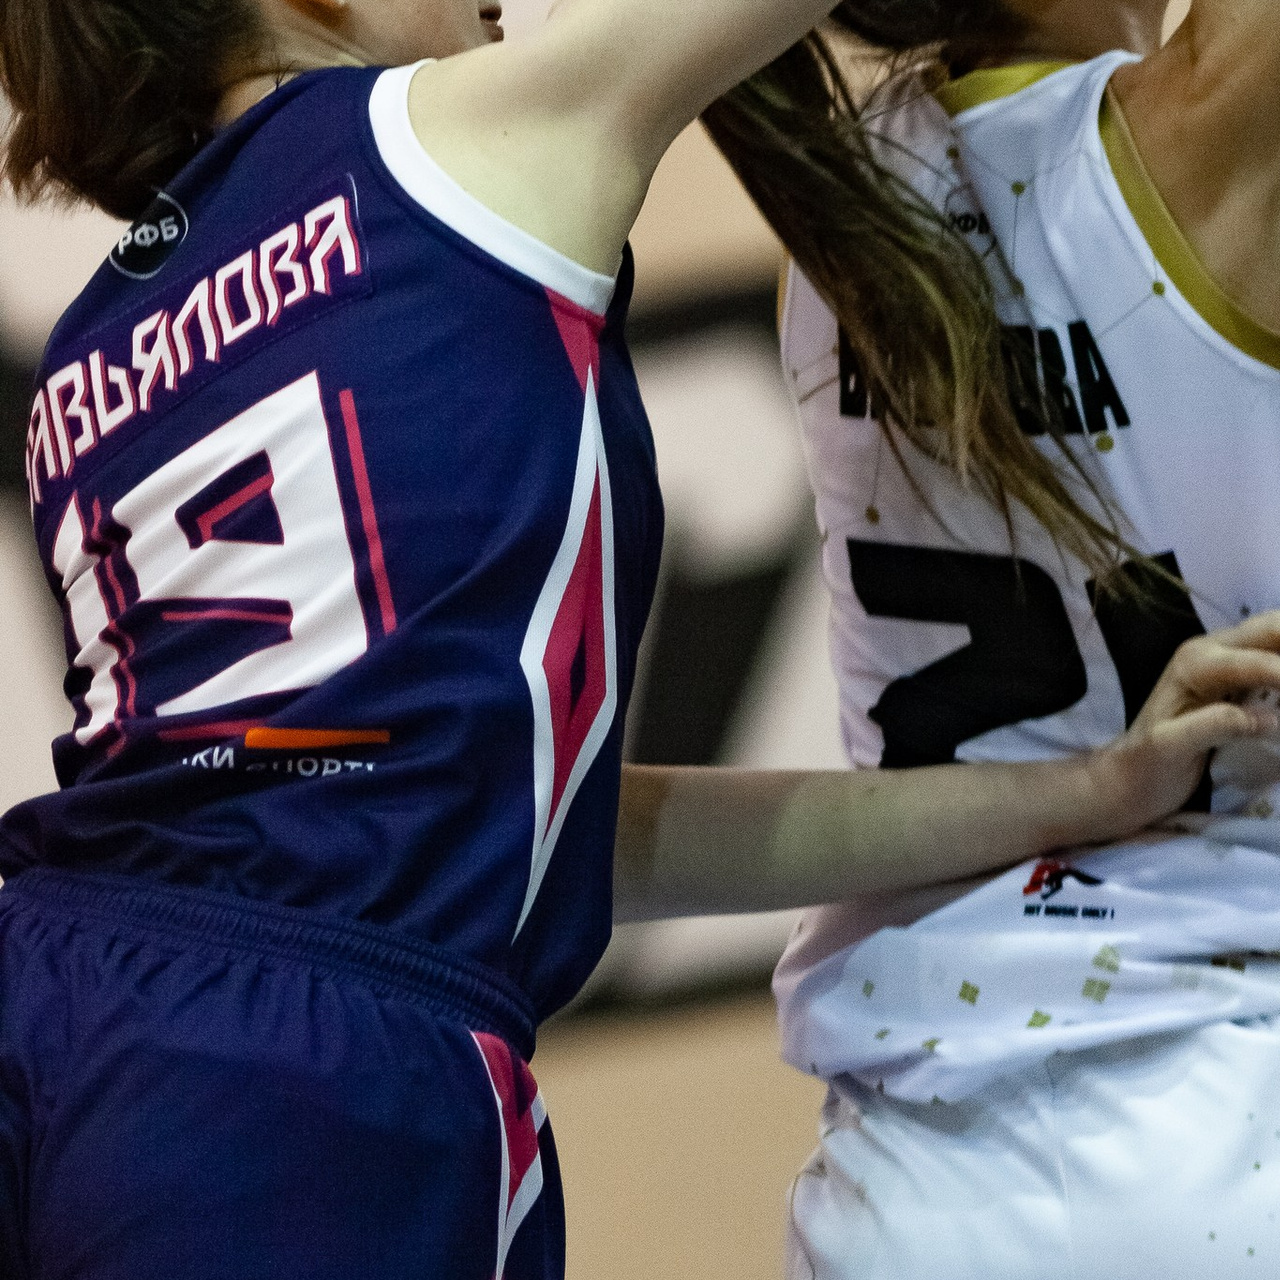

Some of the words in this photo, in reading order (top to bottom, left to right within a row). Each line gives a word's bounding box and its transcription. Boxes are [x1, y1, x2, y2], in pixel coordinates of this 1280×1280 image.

[25, 194, 361, 520] АВЬЯЛОВА
[118, 215, 179, 255] РФБ
[52, 369, 370, 747] 19
